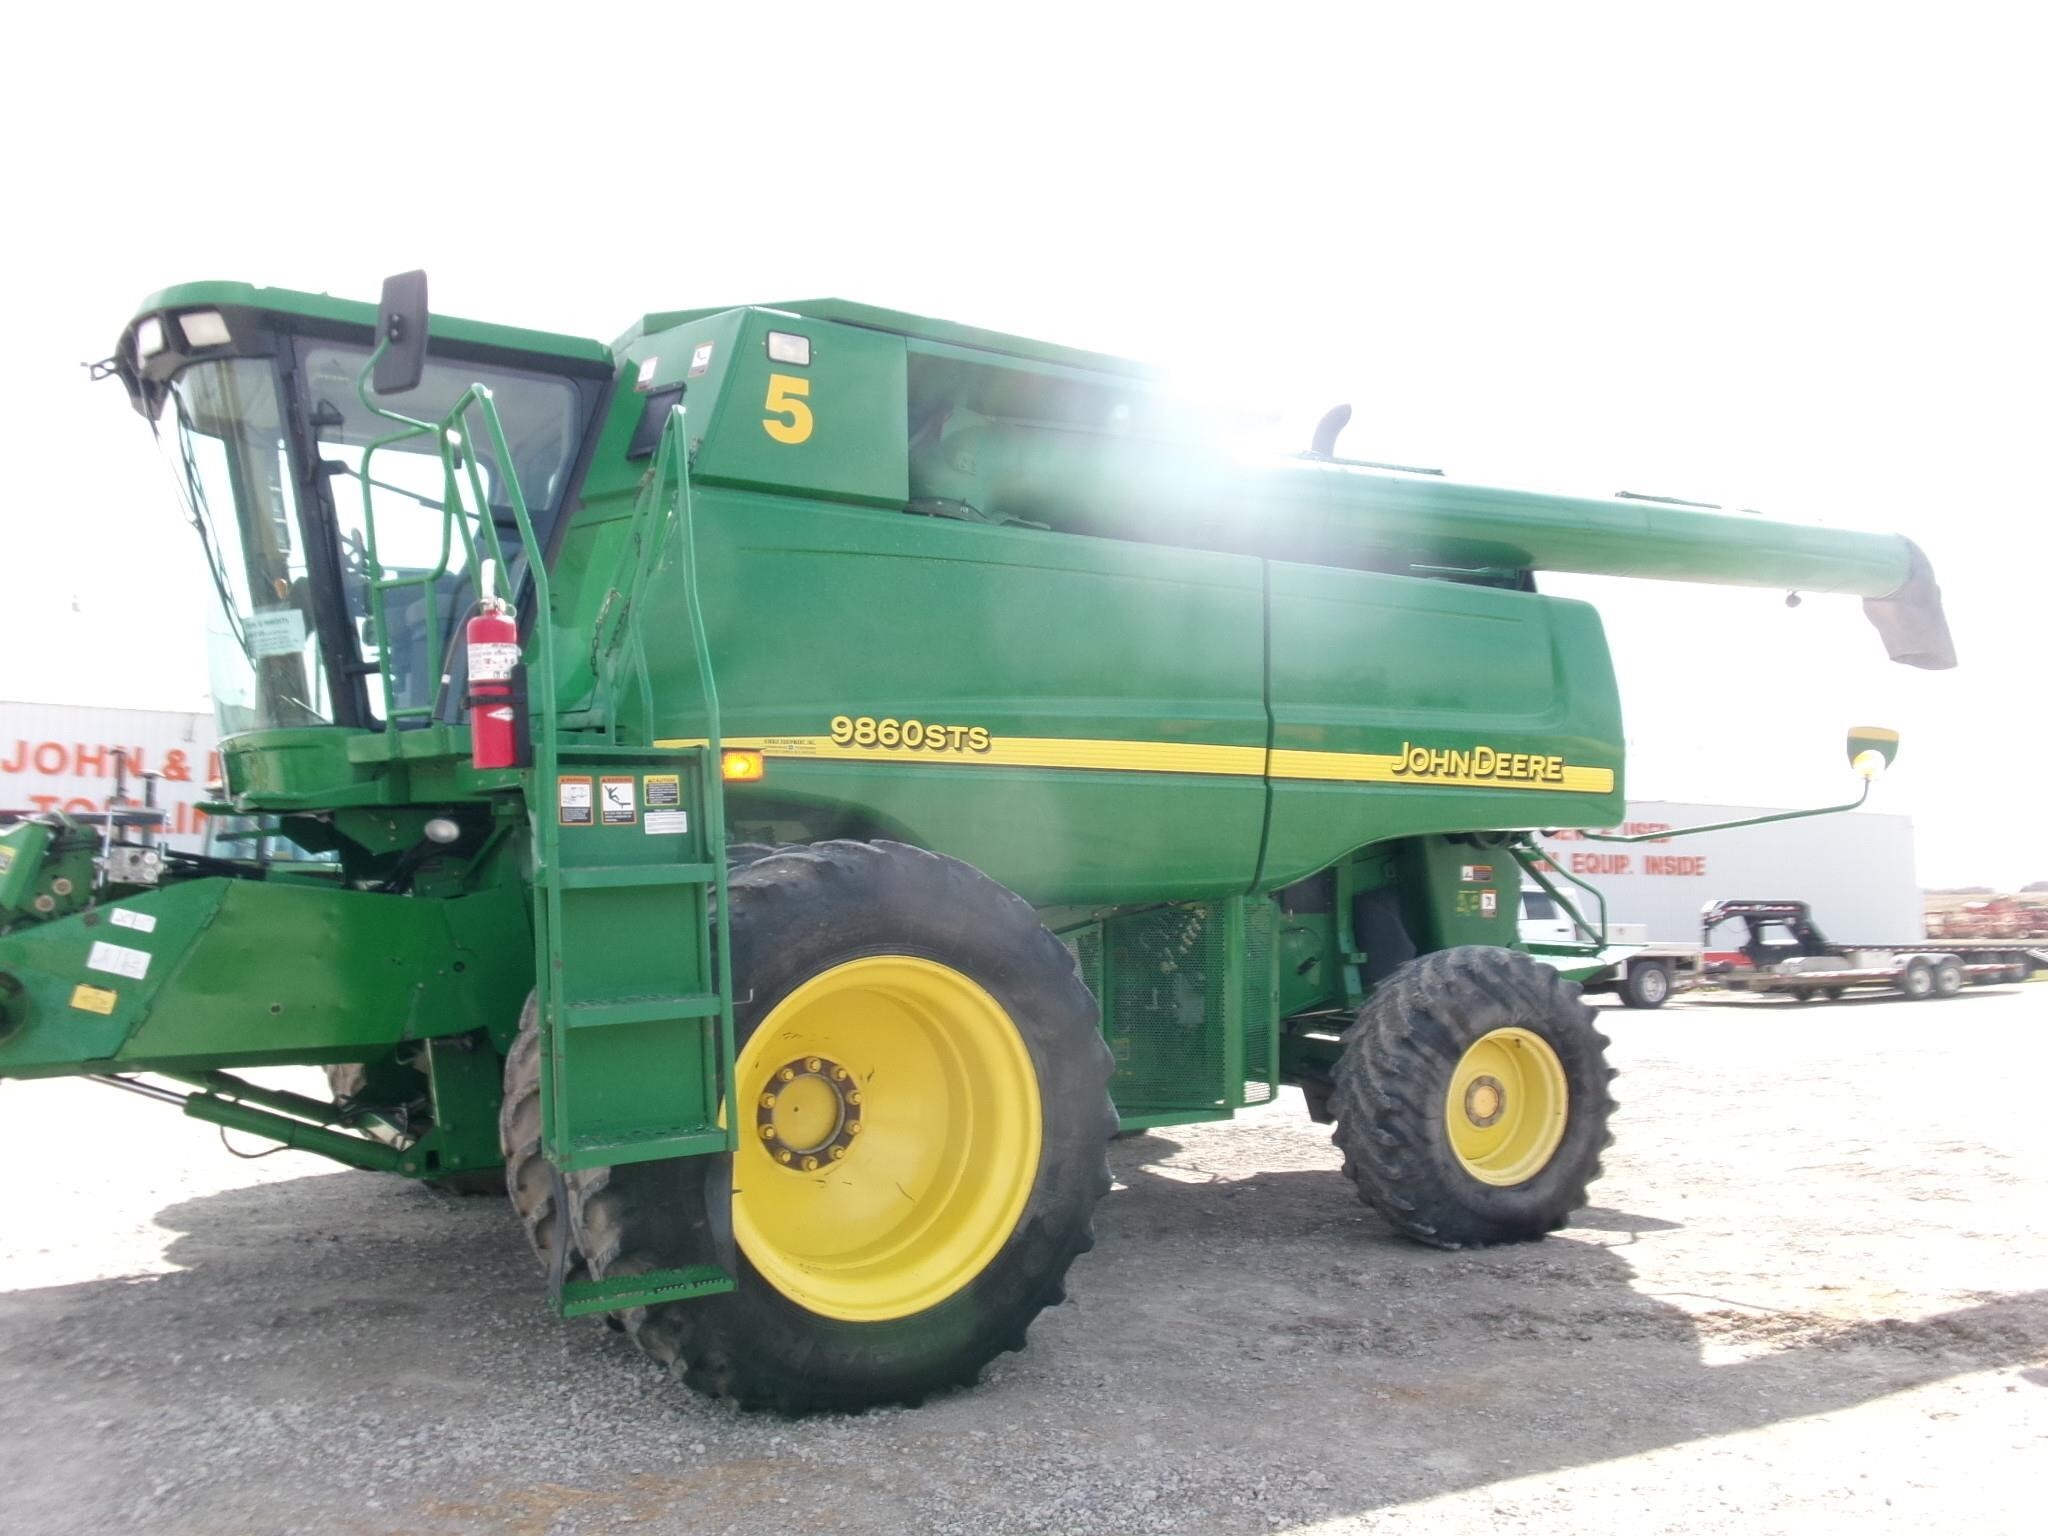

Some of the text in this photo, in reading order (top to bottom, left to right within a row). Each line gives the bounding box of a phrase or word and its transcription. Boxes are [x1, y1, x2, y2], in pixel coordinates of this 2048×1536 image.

[762, 373, 814, 445] 5
[830, 715, 992, 754] 9860STS
[1, 739, 144, 779] JOHN
[163, 749, 192, 782] &
[1643, 855, 1706, 876] INSIDE
